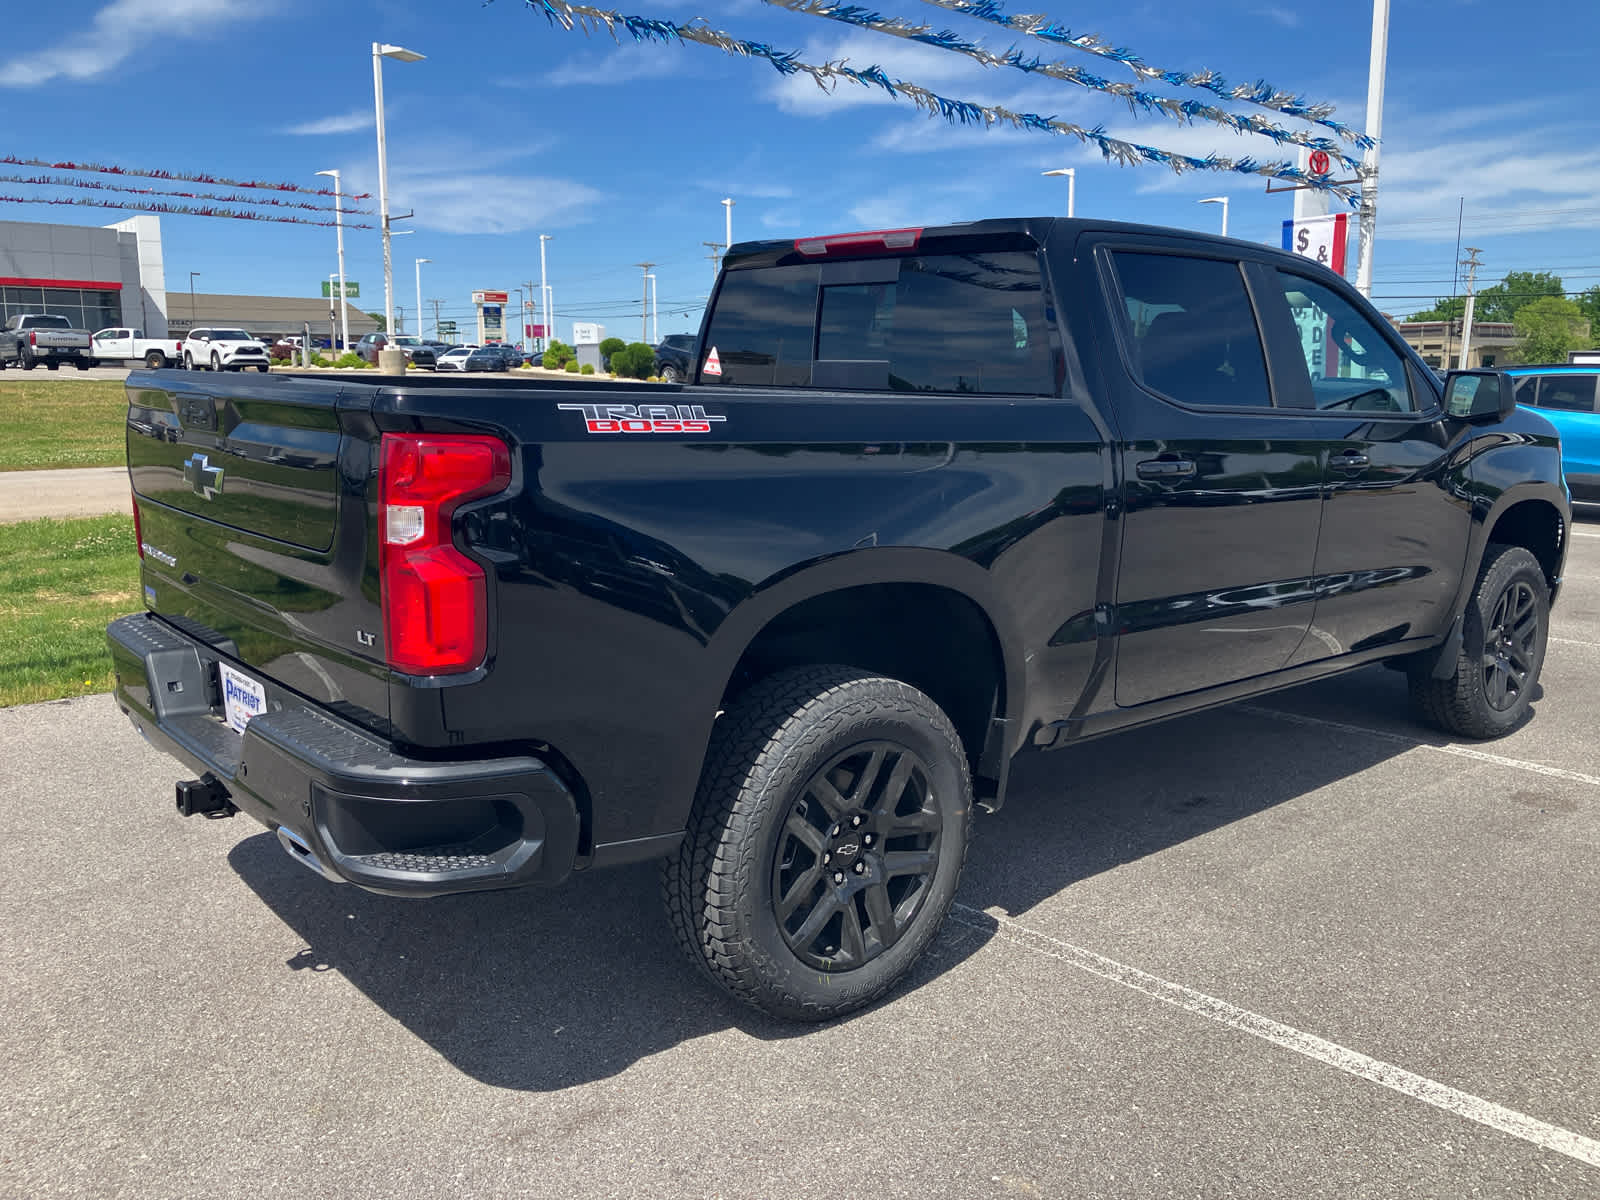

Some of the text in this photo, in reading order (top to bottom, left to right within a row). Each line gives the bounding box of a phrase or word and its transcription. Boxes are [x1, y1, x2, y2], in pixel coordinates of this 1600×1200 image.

[557, 403, 727, 422] TRAIL
[586, 419, 711, 434] BOSS
[356, 630, 376, 647] LT
[226, 677, 261, 713] PATRIOT
